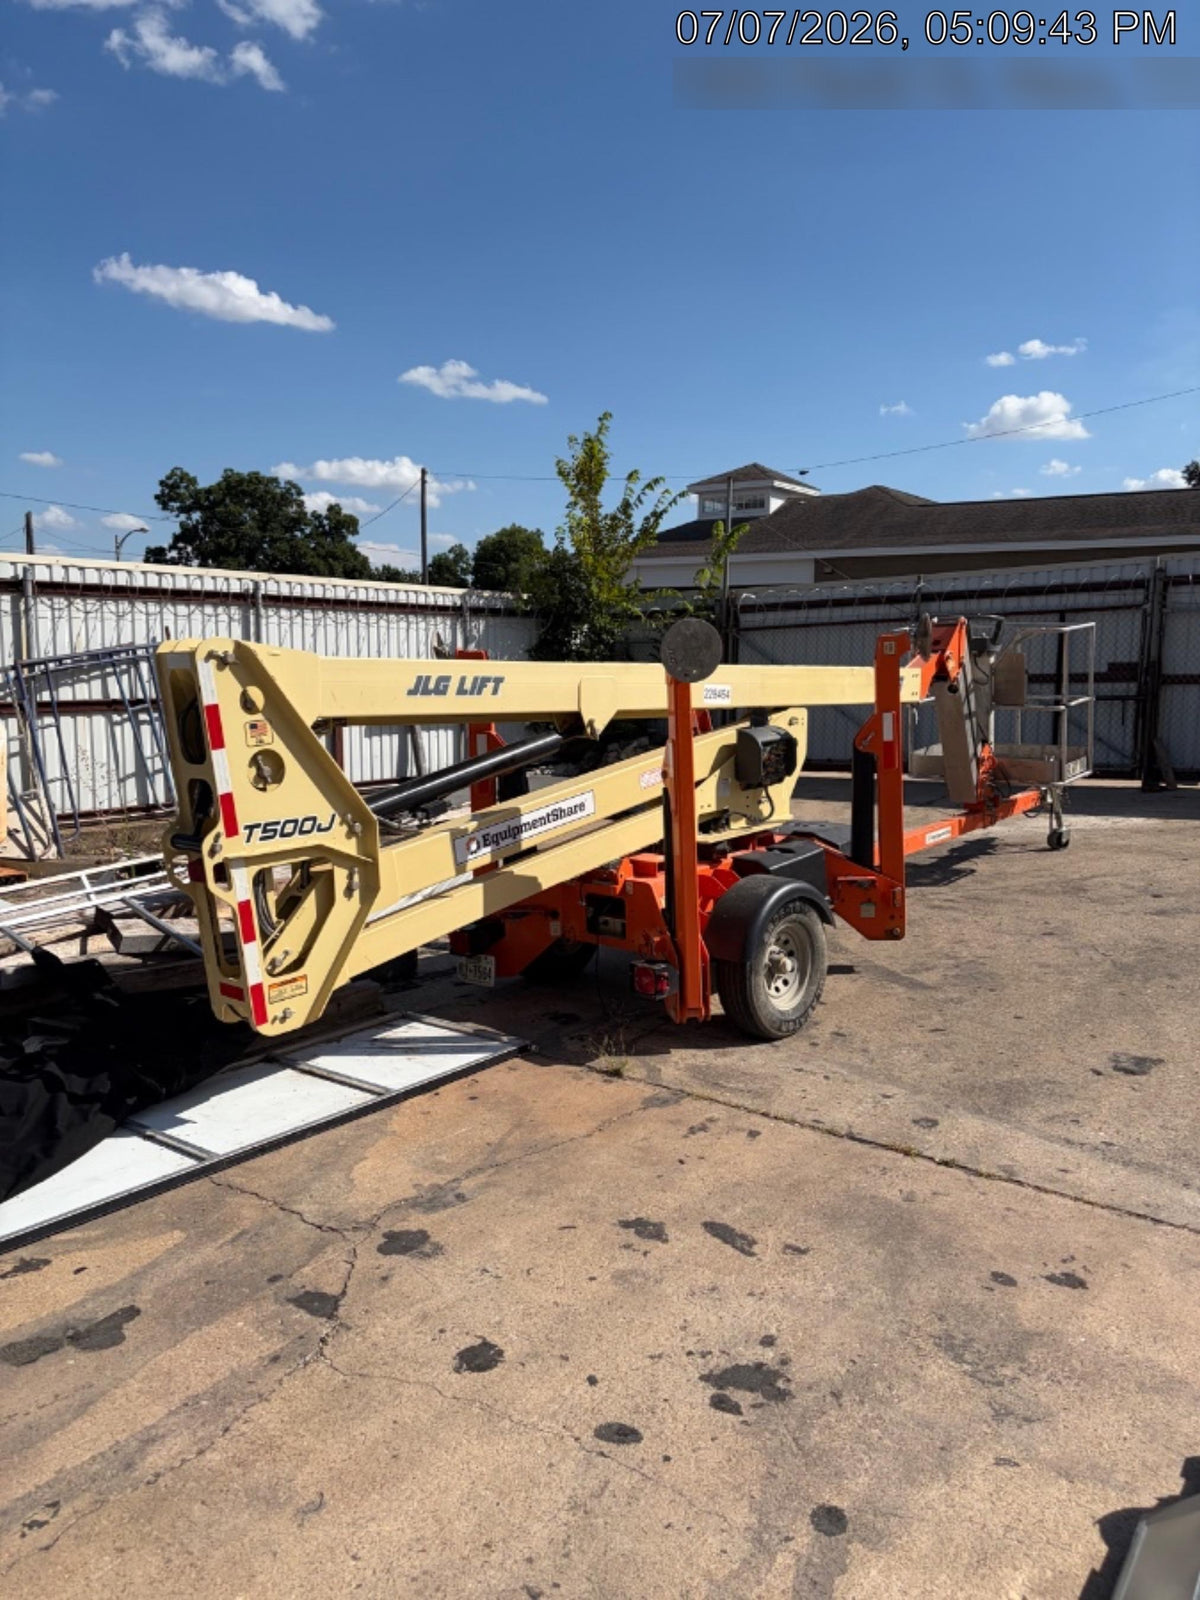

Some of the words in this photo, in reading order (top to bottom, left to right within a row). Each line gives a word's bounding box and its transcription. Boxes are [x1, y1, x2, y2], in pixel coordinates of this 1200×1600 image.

[406, 675, 452, 696] JLG
[455, 675, 505, 696] LIFT
[243, 813, 336, 844] T500J
[482, 801, 586, 847] EquipmentShare
